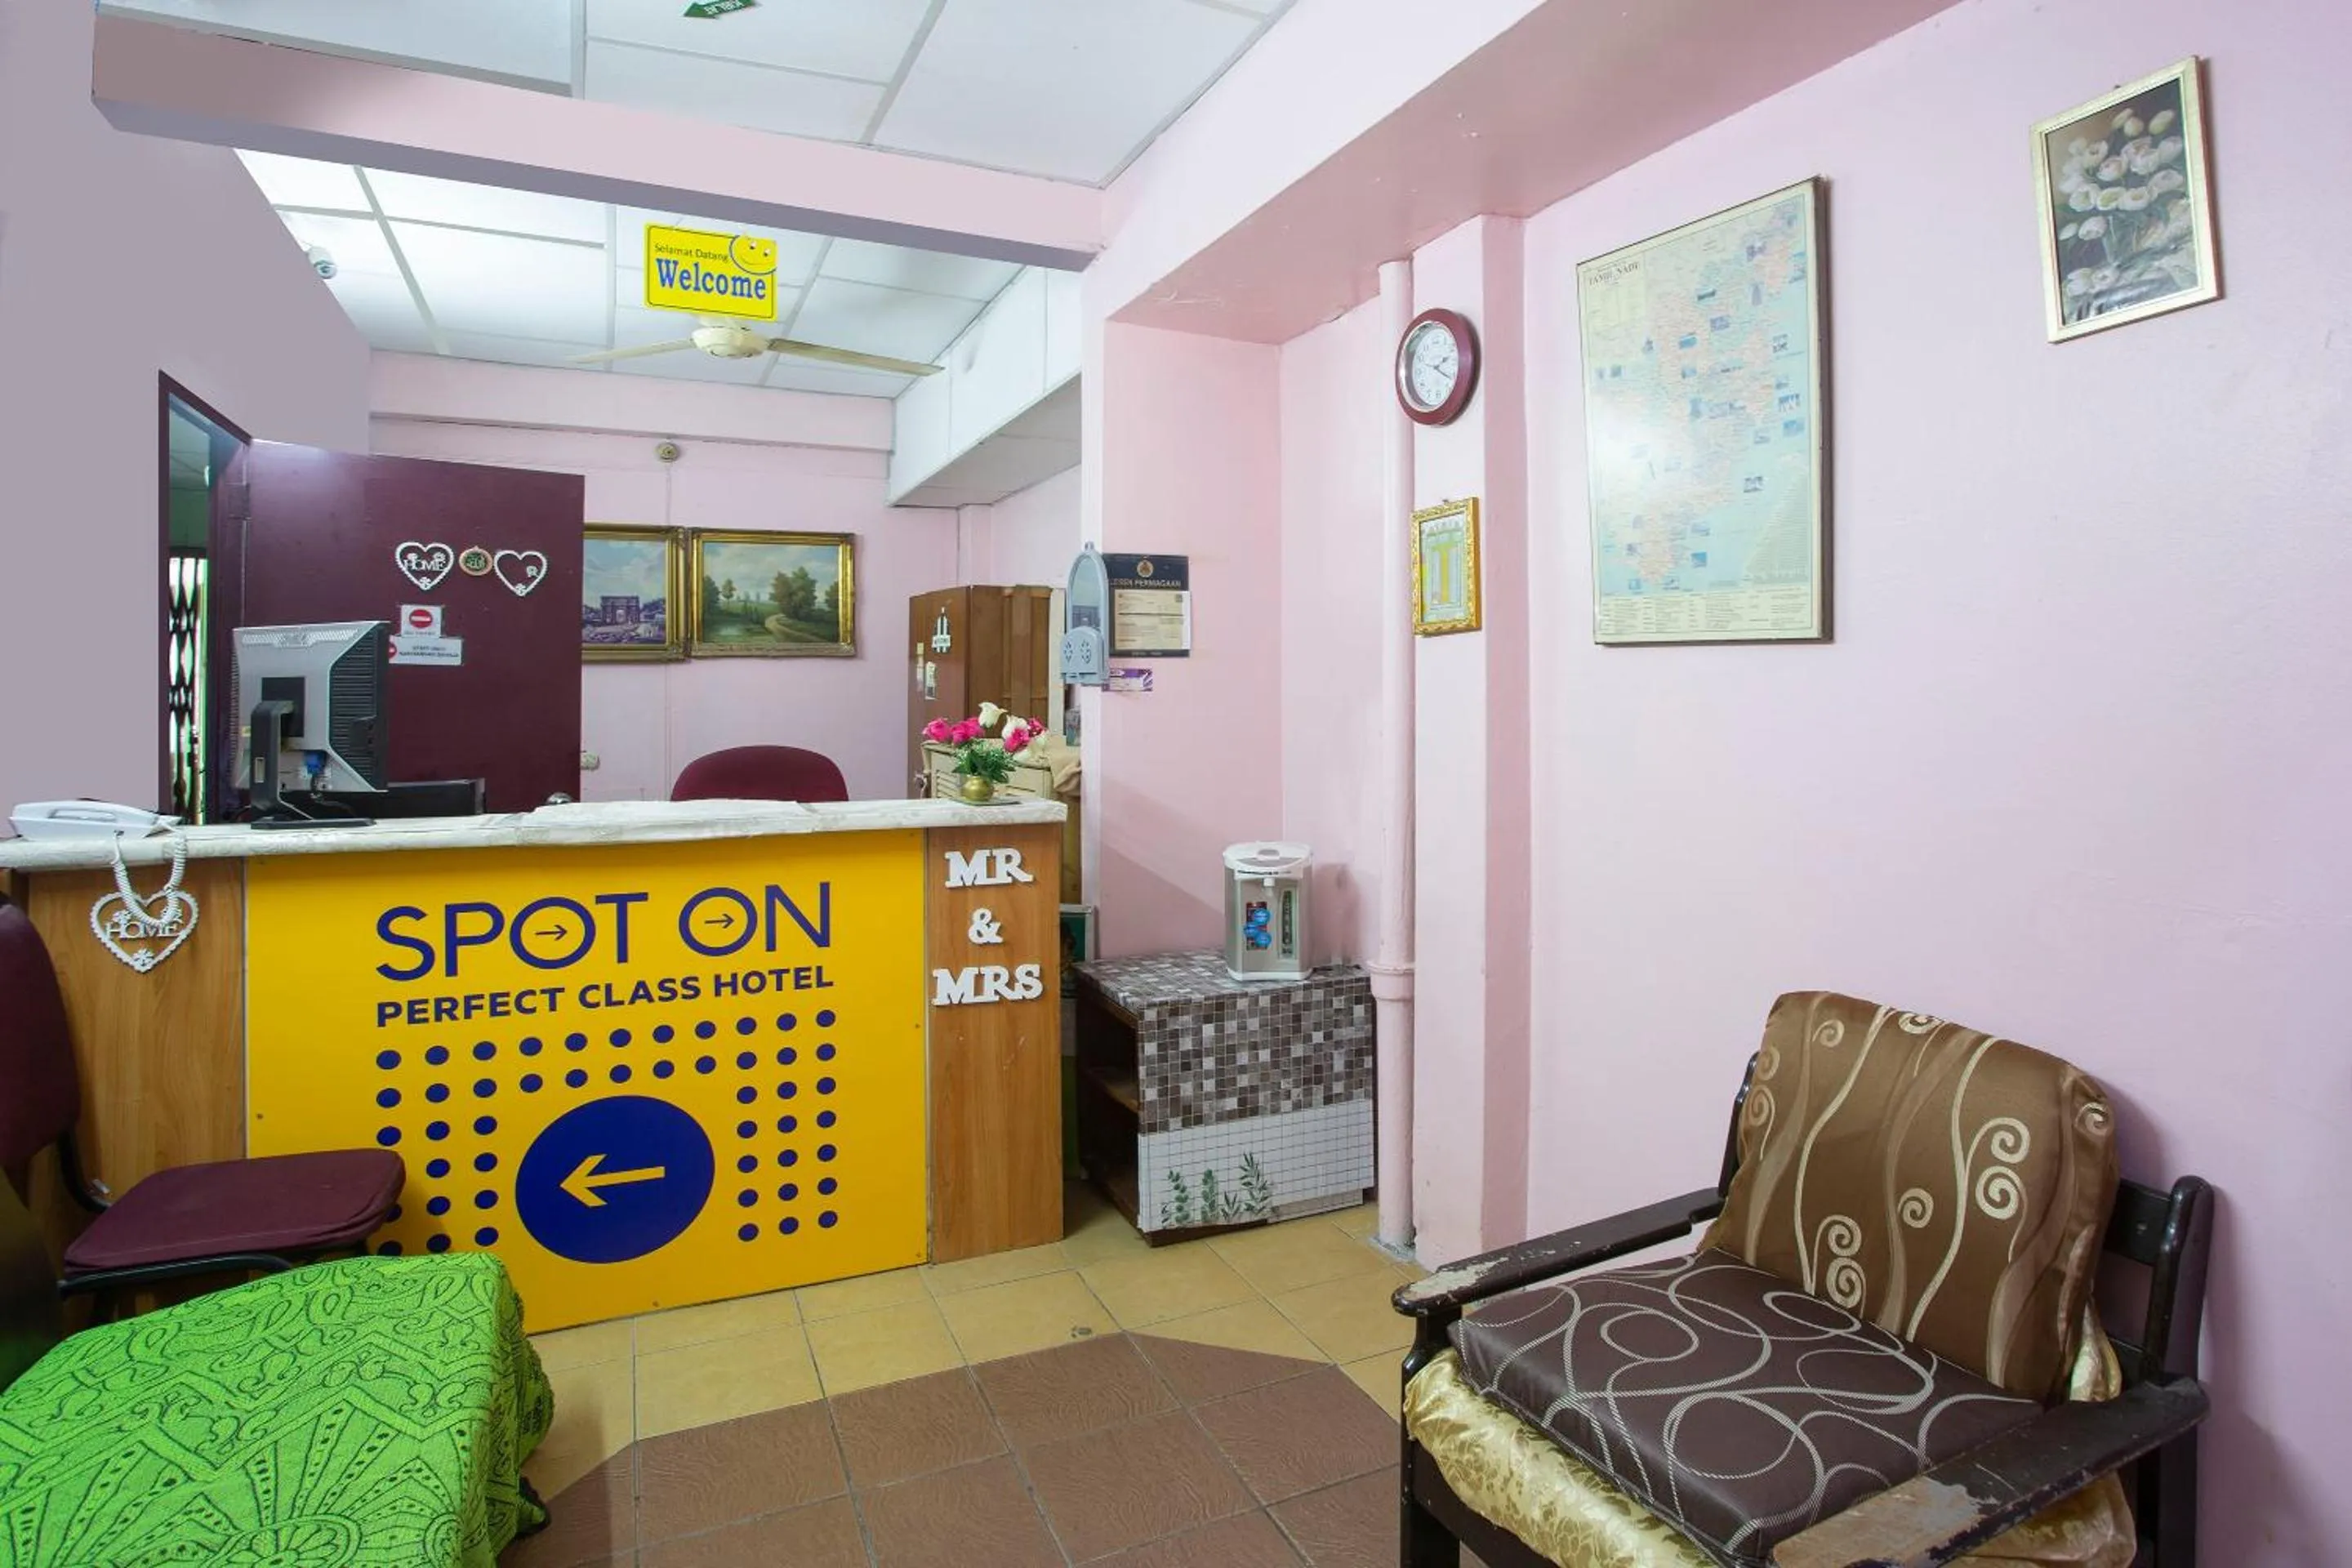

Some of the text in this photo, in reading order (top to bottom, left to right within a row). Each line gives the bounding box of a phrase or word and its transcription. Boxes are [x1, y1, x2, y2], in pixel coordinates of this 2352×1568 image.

[655, 243, 729, 263] Selamat Datang
[655, 257, 766, 300] Welcome
[403, 559, 446, 572] HOME
[944, 847, 1035, 889] MR
[104, 920, 184, 940] HOME
[376, 881, 831, 981] SPOT ON
[968, 907, 1004, 944] &
[376, 964, 834, 1027] PERFECT CLASS HOTEL
[931, 963, 1044, 1006] MRS
